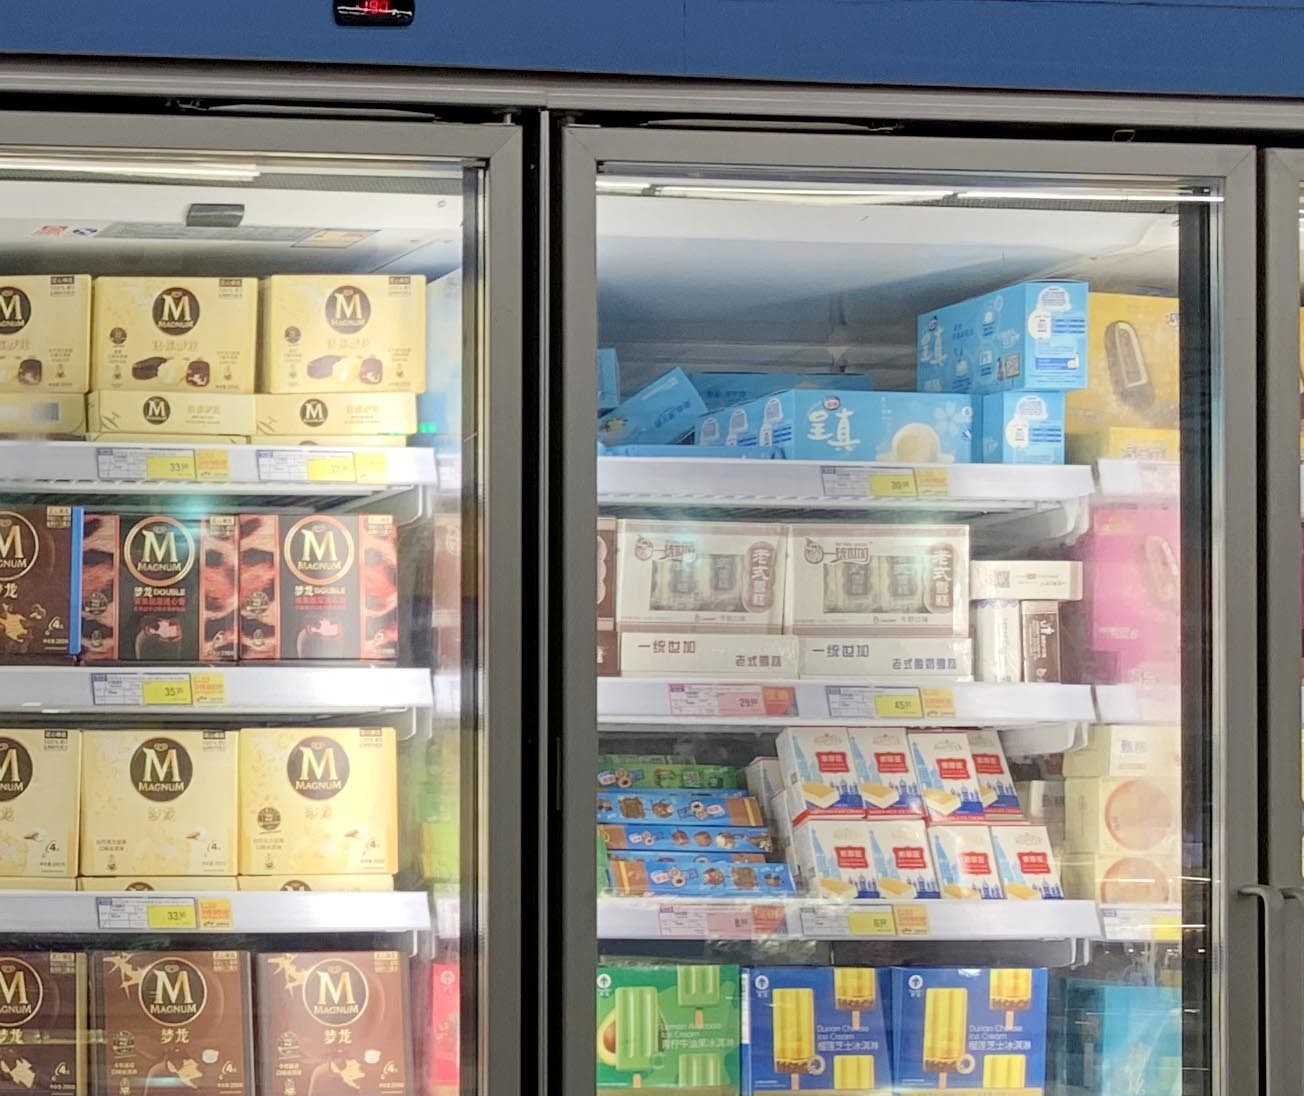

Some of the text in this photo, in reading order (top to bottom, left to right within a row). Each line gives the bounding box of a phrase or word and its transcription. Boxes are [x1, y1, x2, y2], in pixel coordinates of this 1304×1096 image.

[137, 562, 182, 572] MAGNUM
[298, 561, 341, 572] MAGNUM
[153, 588, 185, 596] DOUBLE
[314, 587, 345, 595] DOUBLE
[137, 781, 184, 792] MAGNUM
[295, 781, 342, 791] MAGNUM
[150, 1004, 197, 1015] MAGNUM
[314, 1004, 358, 1015] MAGNUM
[161, 1029, 190, 1044] 梦龙
[324, 1029, 351, 1044] 梦龙
